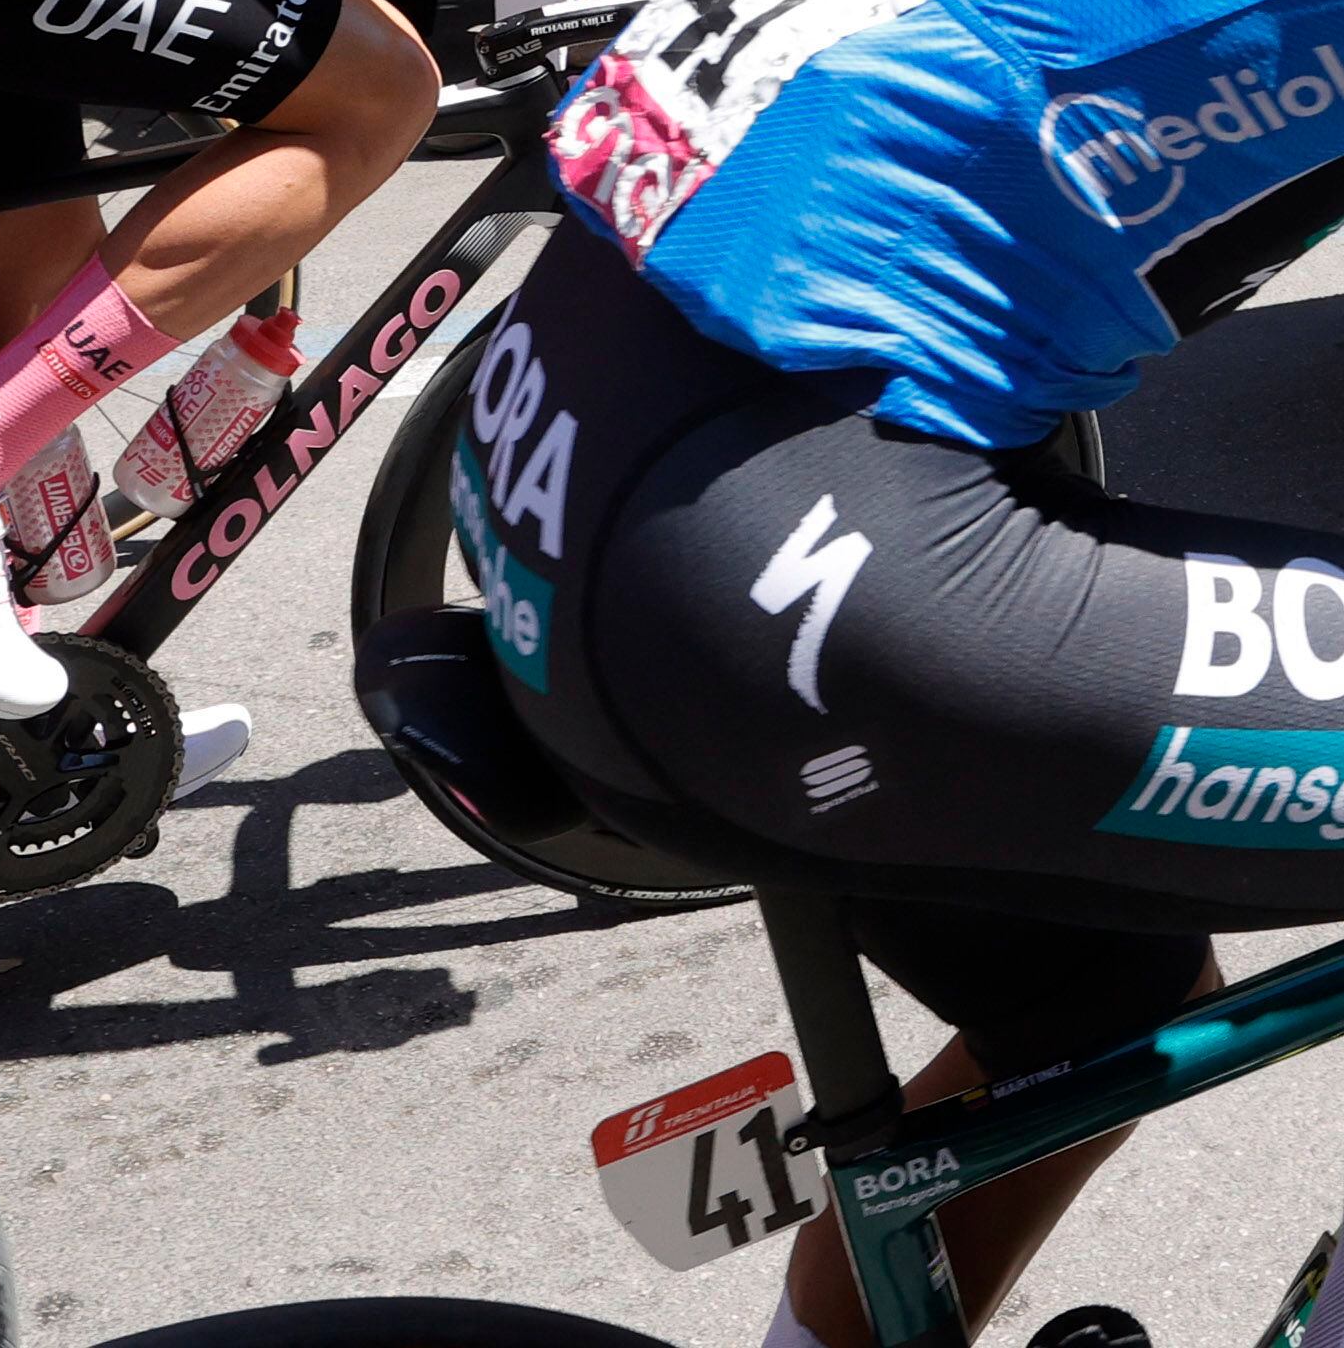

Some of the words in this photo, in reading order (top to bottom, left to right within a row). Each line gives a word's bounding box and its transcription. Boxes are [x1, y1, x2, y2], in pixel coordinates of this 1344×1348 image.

[530, 20, 580, 37] RICHARD
[581, 13, 616, 28] MILLE
[65, 320, 134, 383] UAE
[171, 268, 462, 603] COLNAGO
[992, 1060, 1073, 1101] MARTINEZ
[663, 1084, 757, 1130] TRENITALIA
[687, 1104, 814, 1250] 41
[853, 1147, 961, 1201] BORA
[861, 1179, 961, 1219] hansgrohe
